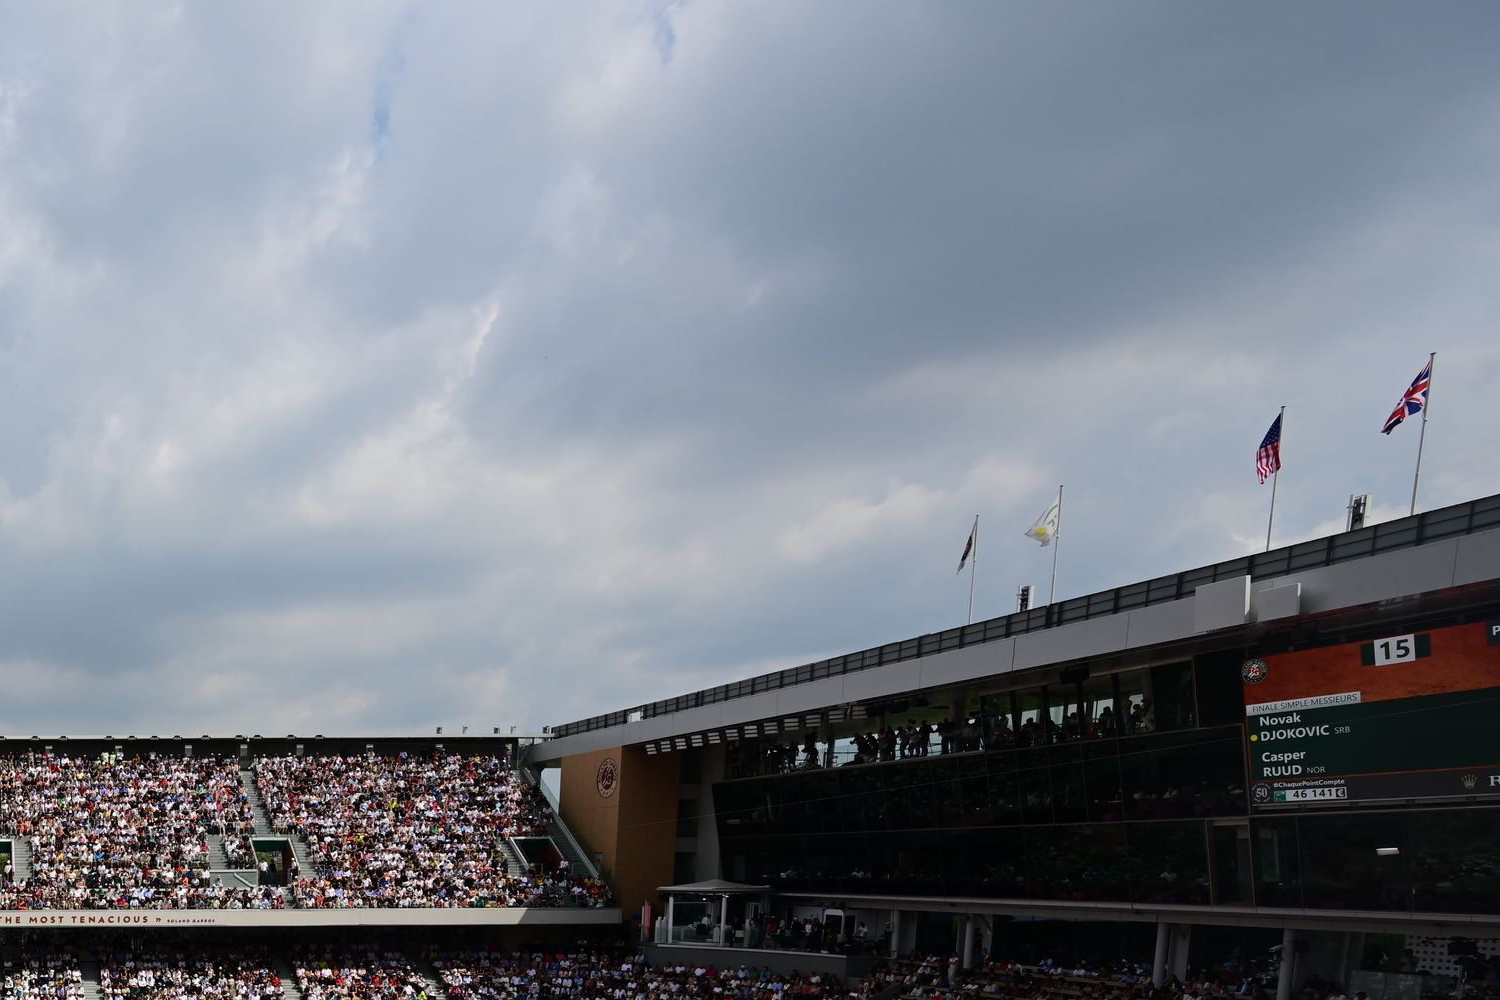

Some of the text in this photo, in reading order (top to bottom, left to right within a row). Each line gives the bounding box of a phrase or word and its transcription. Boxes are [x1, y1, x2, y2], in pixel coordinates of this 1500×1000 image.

[1379, 638, 1410, 661] 15
[1252, 693, 1358, 713] FINALE SIMPLE MESSIEURS
[1259, 712, 1301, 727] Novak
[1260, 725, 1350, 742] DJOKOVIC SRB
[1262, 751, 1306, 763] Casper
[1263, 764, 1326, 777] RUUD NOR
[1273, 778, 1345, 788] #ChaquePointCompte
[1255, 787, 1268, 798] 50
[1292, 790, 1308, 799] 46
[1311, 788, 1333, 798] 141
[28, 915, 64, 924] MOST
[71, 915, 149, 924] TENACIOUS
